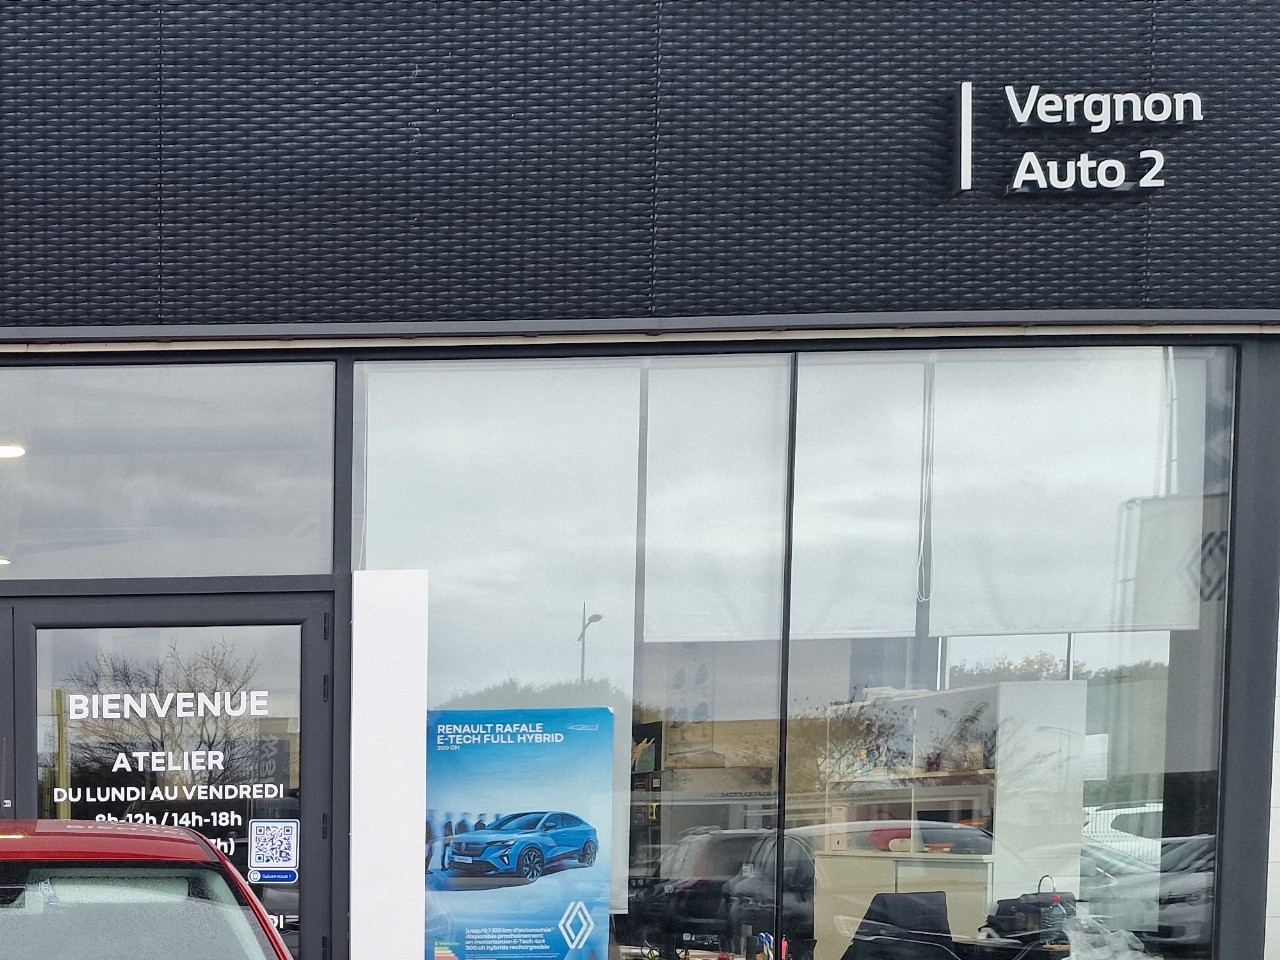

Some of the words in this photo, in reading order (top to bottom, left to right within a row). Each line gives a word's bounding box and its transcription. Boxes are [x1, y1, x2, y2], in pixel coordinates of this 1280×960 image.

[1005, 85, 1203, 133] Vergnon
[1012, 151, 1126, 189] Auto
[1139, 150, 1165, 188] 2
[69, 690, 269, 720] BIENVENUE
[437, 724, 494, 734] RENAULT
[495, 723, 543, 733] RAFALE
[437, 734, 481, 744] E-TECH
[483, 734, 515, 744] FULL
[517, 732, 564, 743] HYBRID
[112, 751, 224, 772] ATELIER
[53, 787, 81, 802] DU
[86, 786, 146, 802] LUNDI
[150, 785, 178, 801] AU
[183, 784, 284, 800] VENDREDI
[172, 811, 242, 826] 14h-18h
